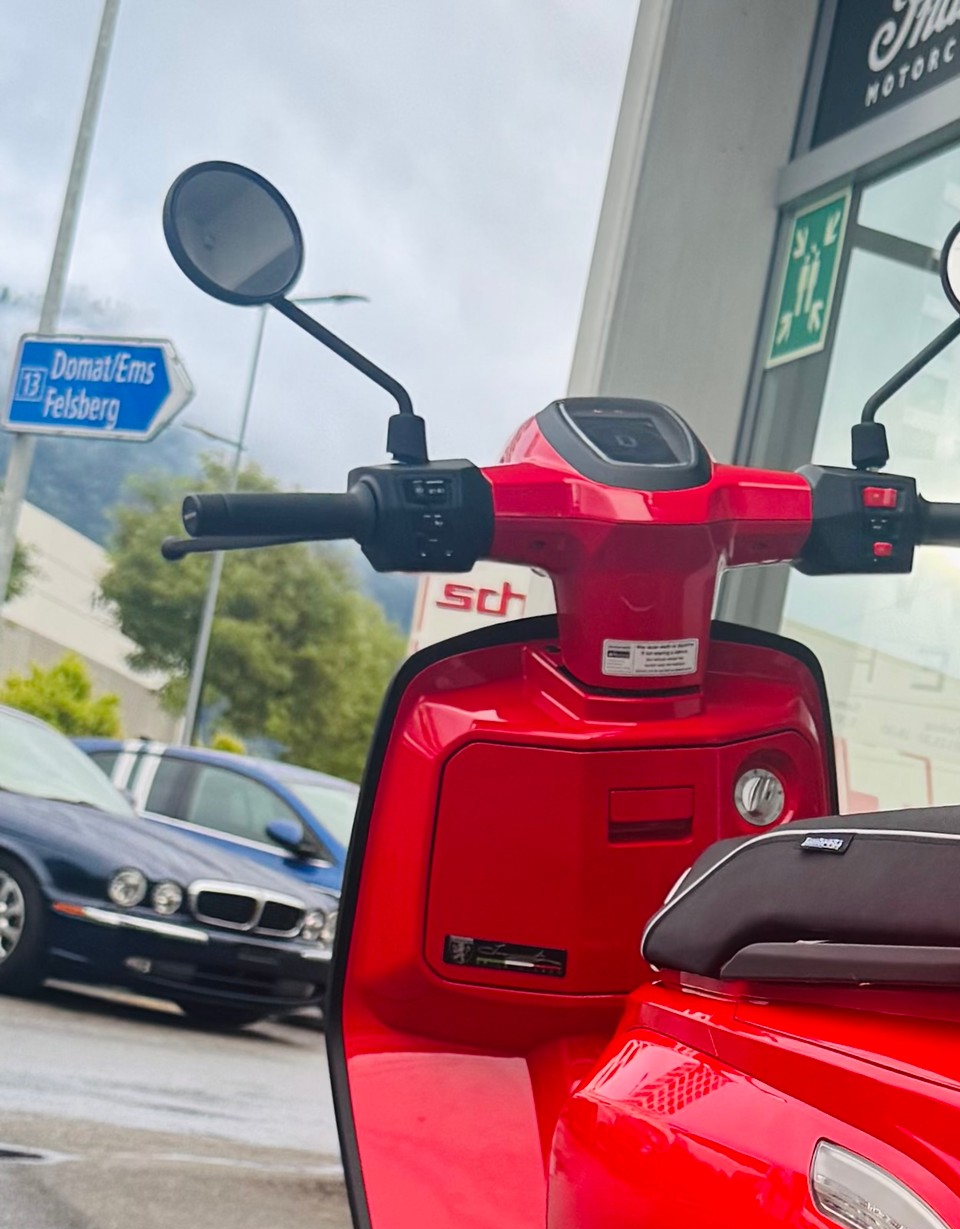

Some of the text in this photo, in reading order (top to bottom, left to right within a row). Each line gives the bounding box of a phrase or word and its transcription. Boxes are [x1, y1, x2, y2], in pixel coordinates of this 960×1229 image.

[22, 371, 42, 397] 13
[51, 350, 156, 385] Domat/Ems
[43, 387, 120, 430] Felsberg
